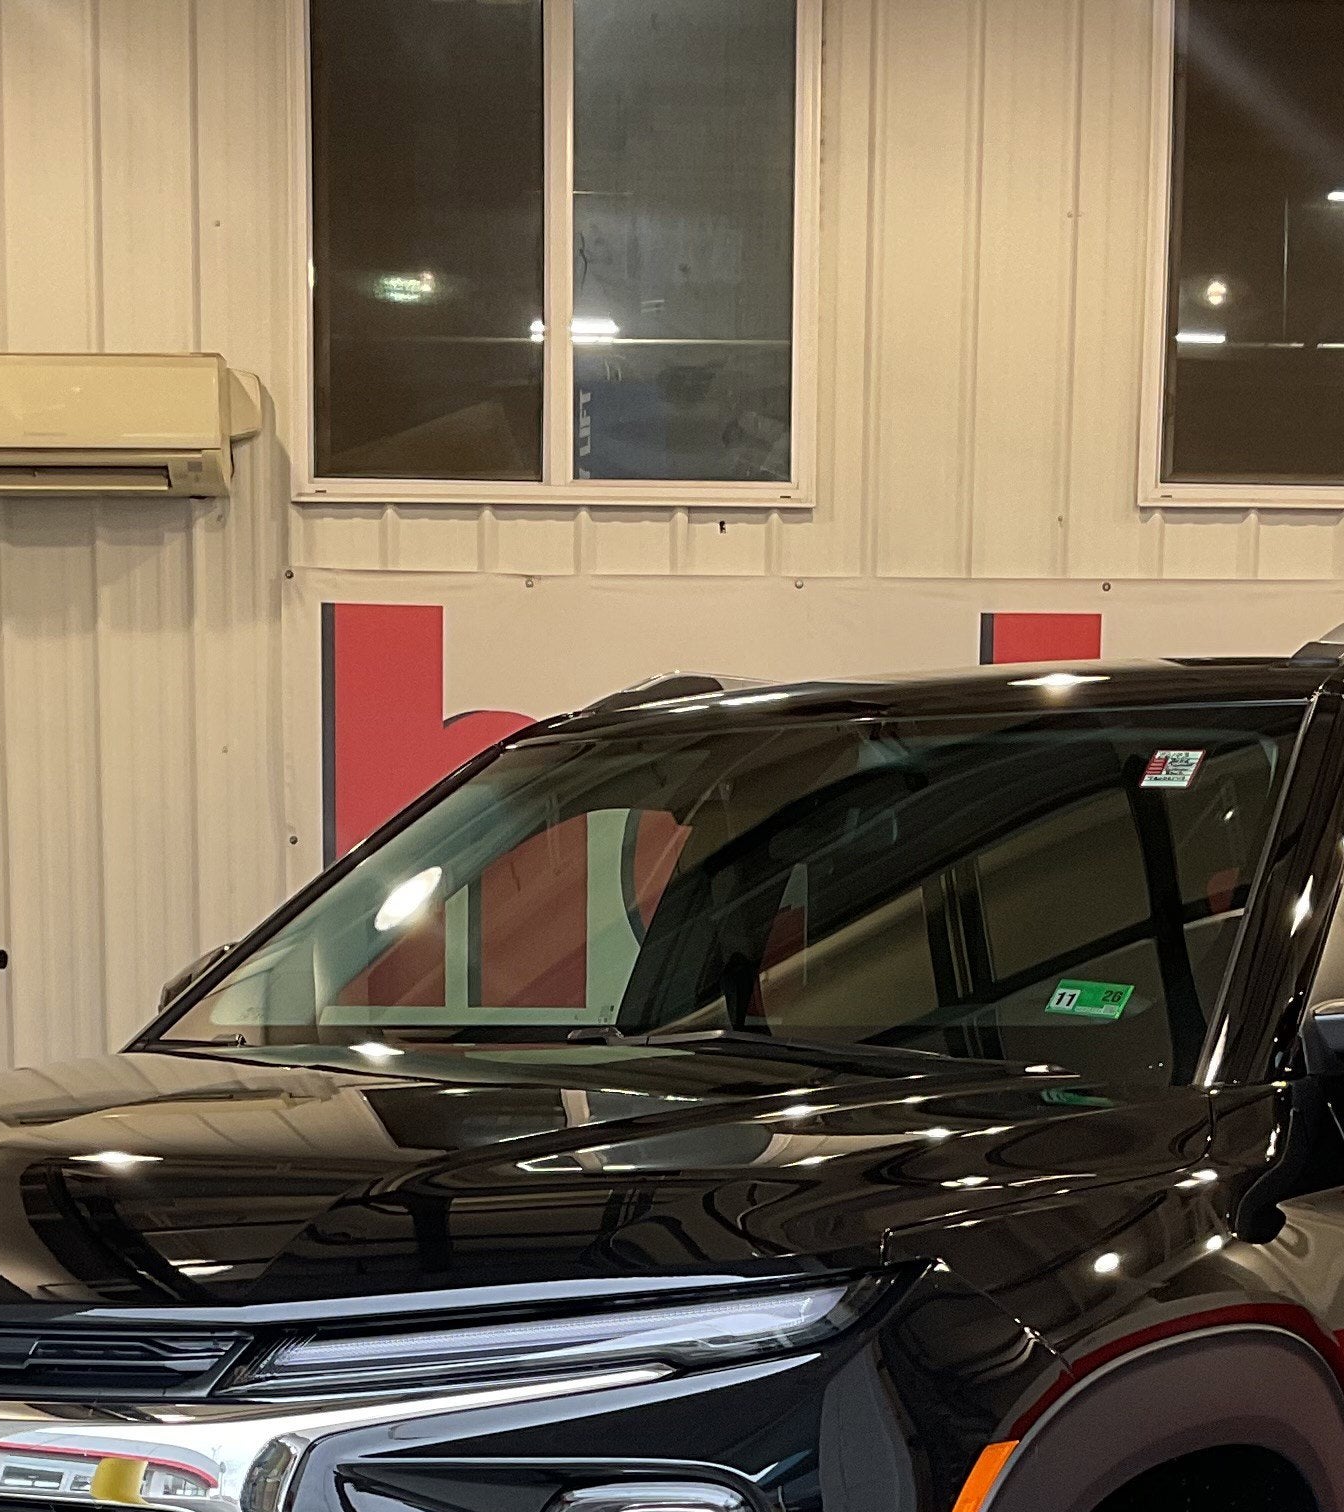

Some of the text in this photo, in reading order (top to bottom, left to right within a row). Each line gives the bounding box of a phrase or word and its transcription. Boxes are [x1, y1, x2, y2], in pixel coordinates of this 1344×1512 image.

[579, 390, 592, 457] LIFT
[1055, 991, 1077, 1007] 11
[1101, 990, 1124, 1003] 26
